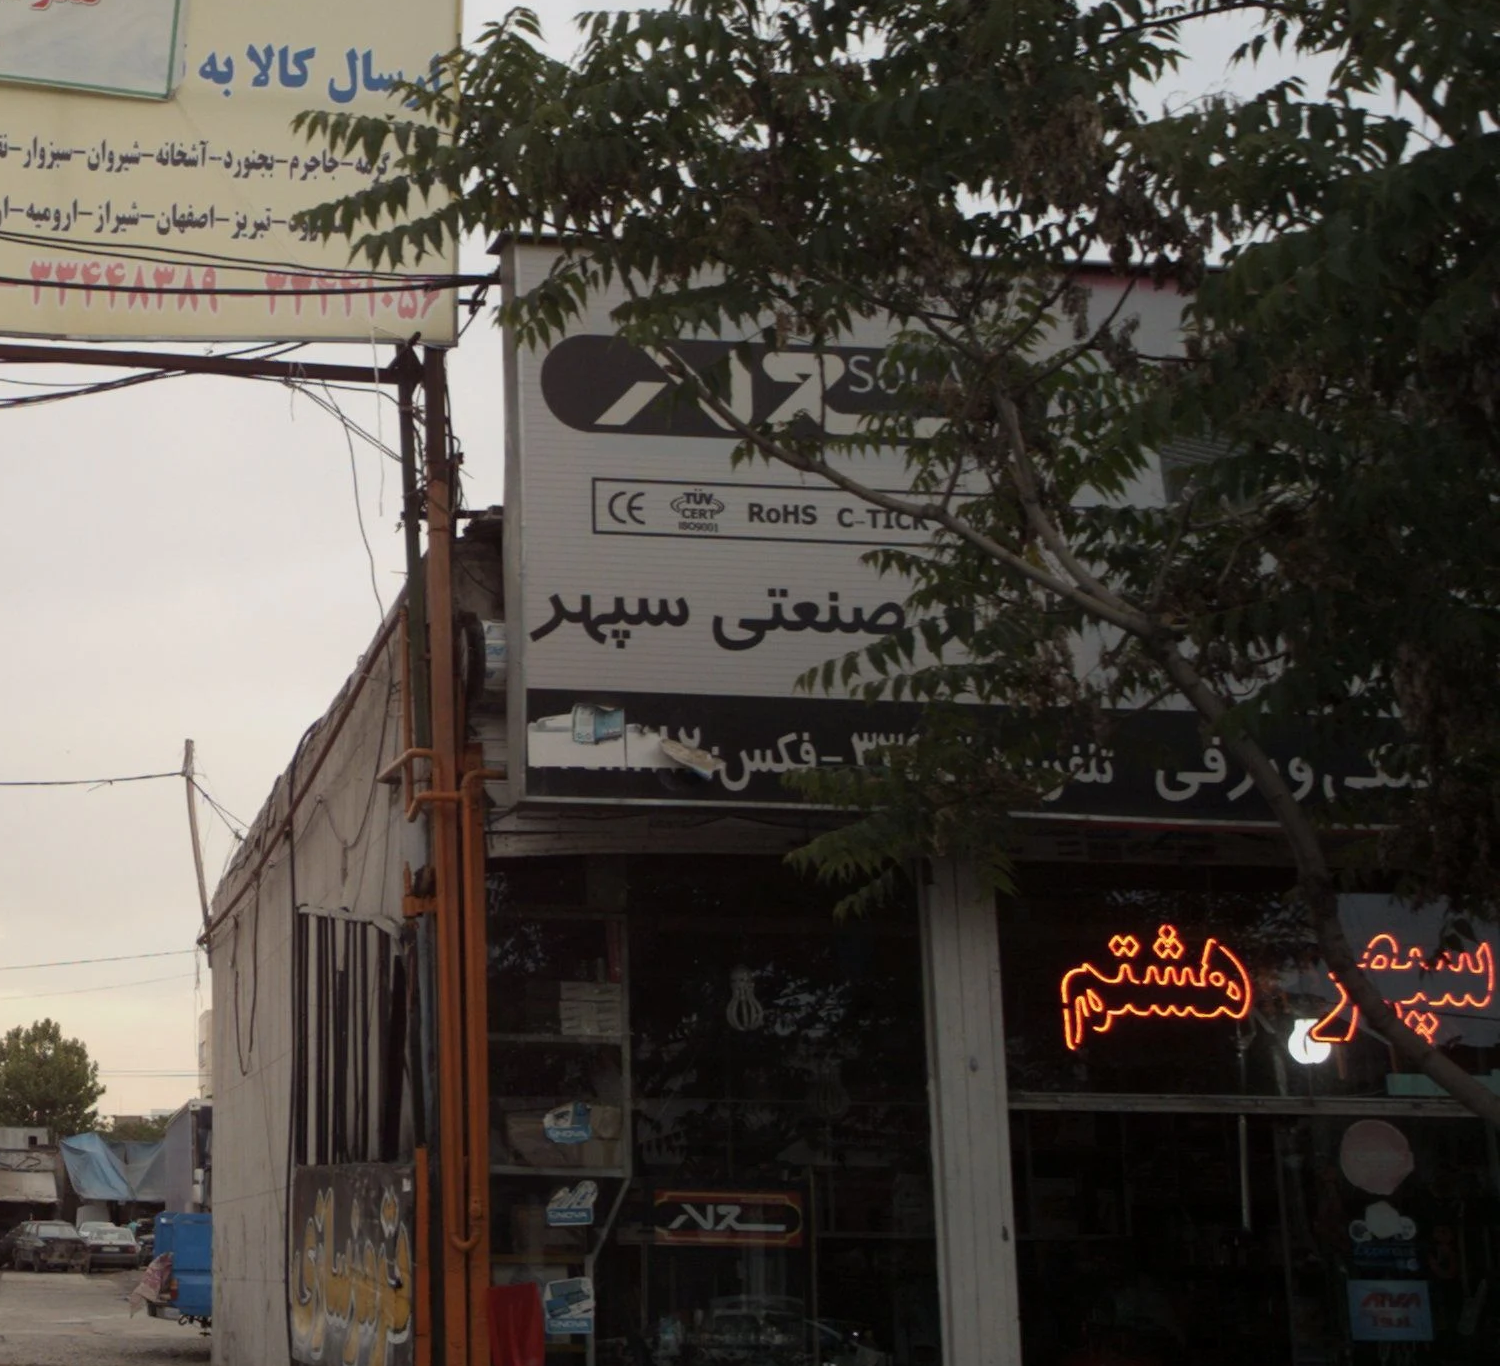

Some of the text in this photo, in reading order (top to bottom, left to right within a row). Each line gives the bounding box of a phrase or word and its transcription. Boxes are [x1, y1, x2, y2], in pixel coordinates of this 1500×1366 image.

[199, 44, 443, 109] ارسال کالا به
[23, 136, 73, 170] سبزوار
[86, 139, 141, 173] شیروان
[156, 140, 208, 168] آشخانه
[223, 147, 275, 180] بجنورد
[289, 148, 340, 181] جاجرم
[25, 199, 78, 231] ارومیه
[95, 199, 140, 234] شیراز
[155, 203, 215, 236] اصفهان
[230, 208, 272, 241] تبریز
[682, 507, 716, 521] CERT
[749, 503, 817, 526] RoHS
[530, 592, 690, 650] سپهر
[712, 587, 906, 652] صنعتی
